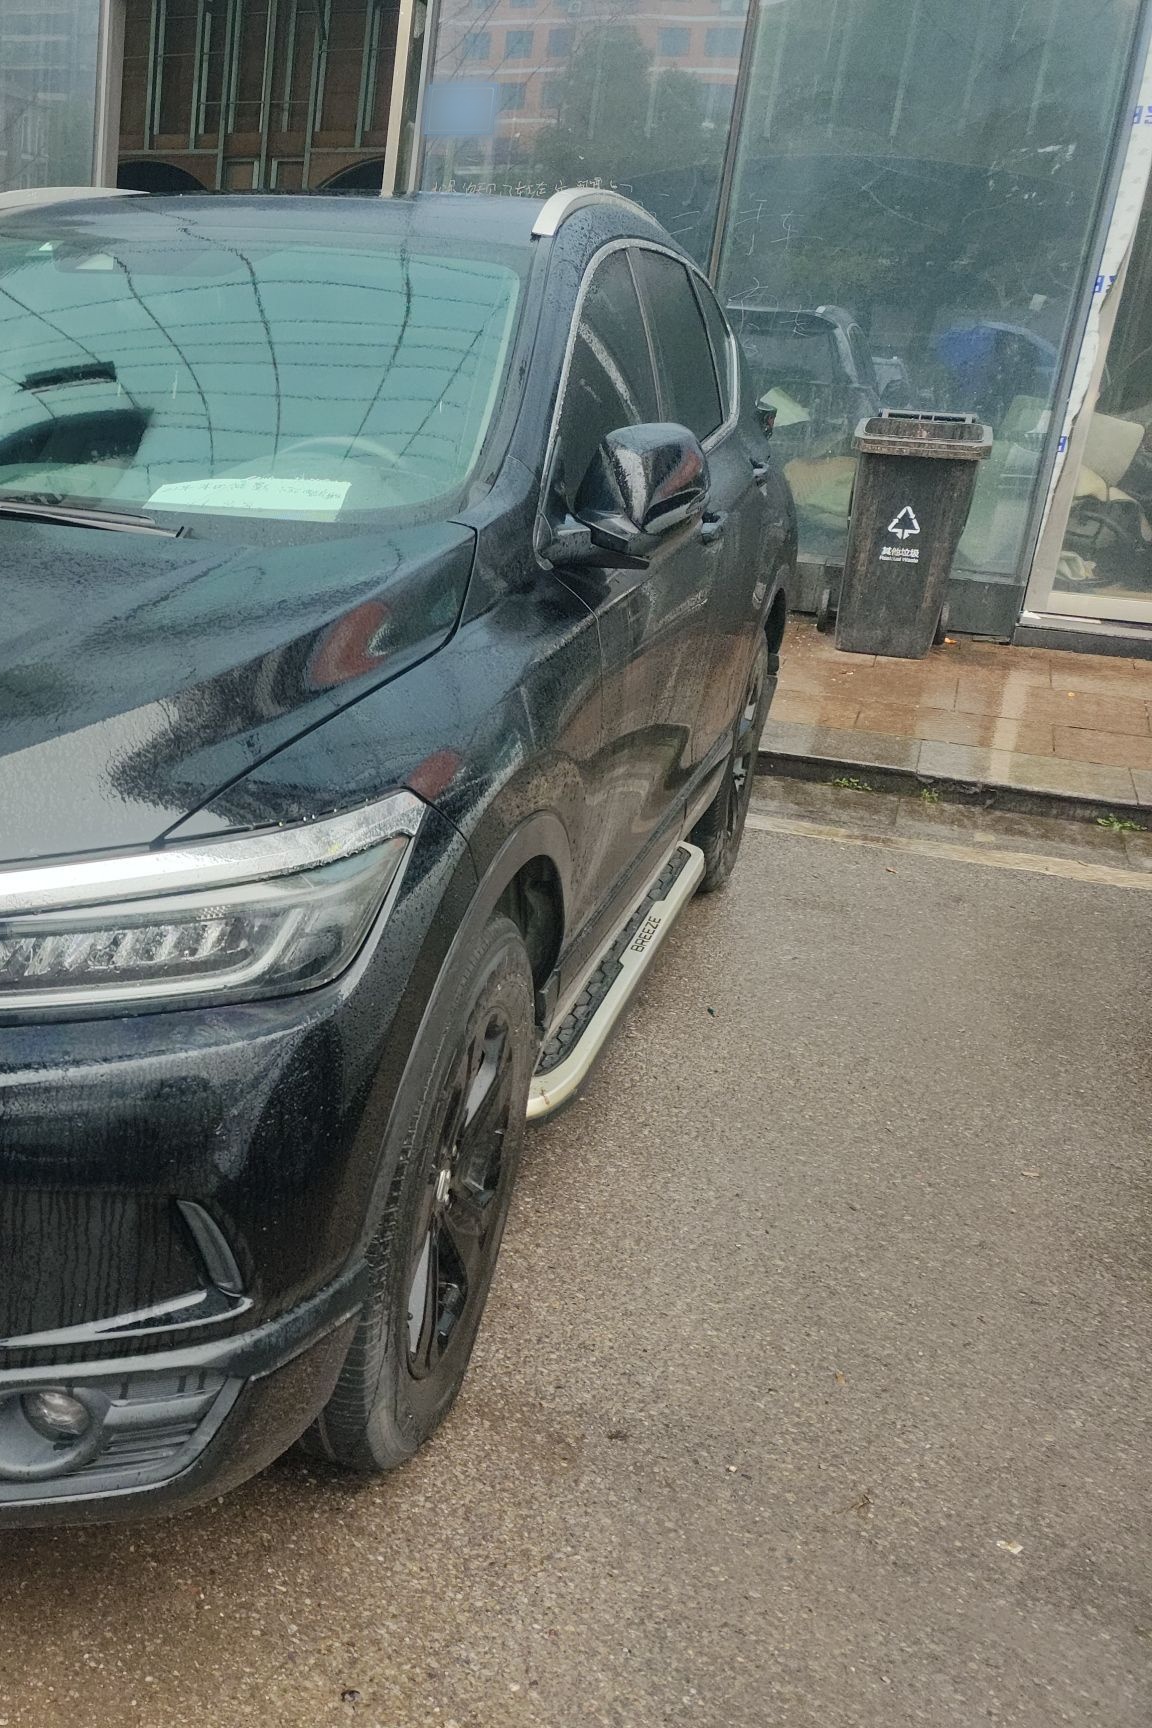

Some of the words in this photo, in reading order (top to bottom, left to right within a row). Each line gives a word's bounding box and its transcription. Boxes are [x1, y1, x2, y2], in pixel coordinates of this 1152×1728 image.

[881, 546, 919, 558] 其他垃圾
[630, 916, 661, 952] BREEZE
